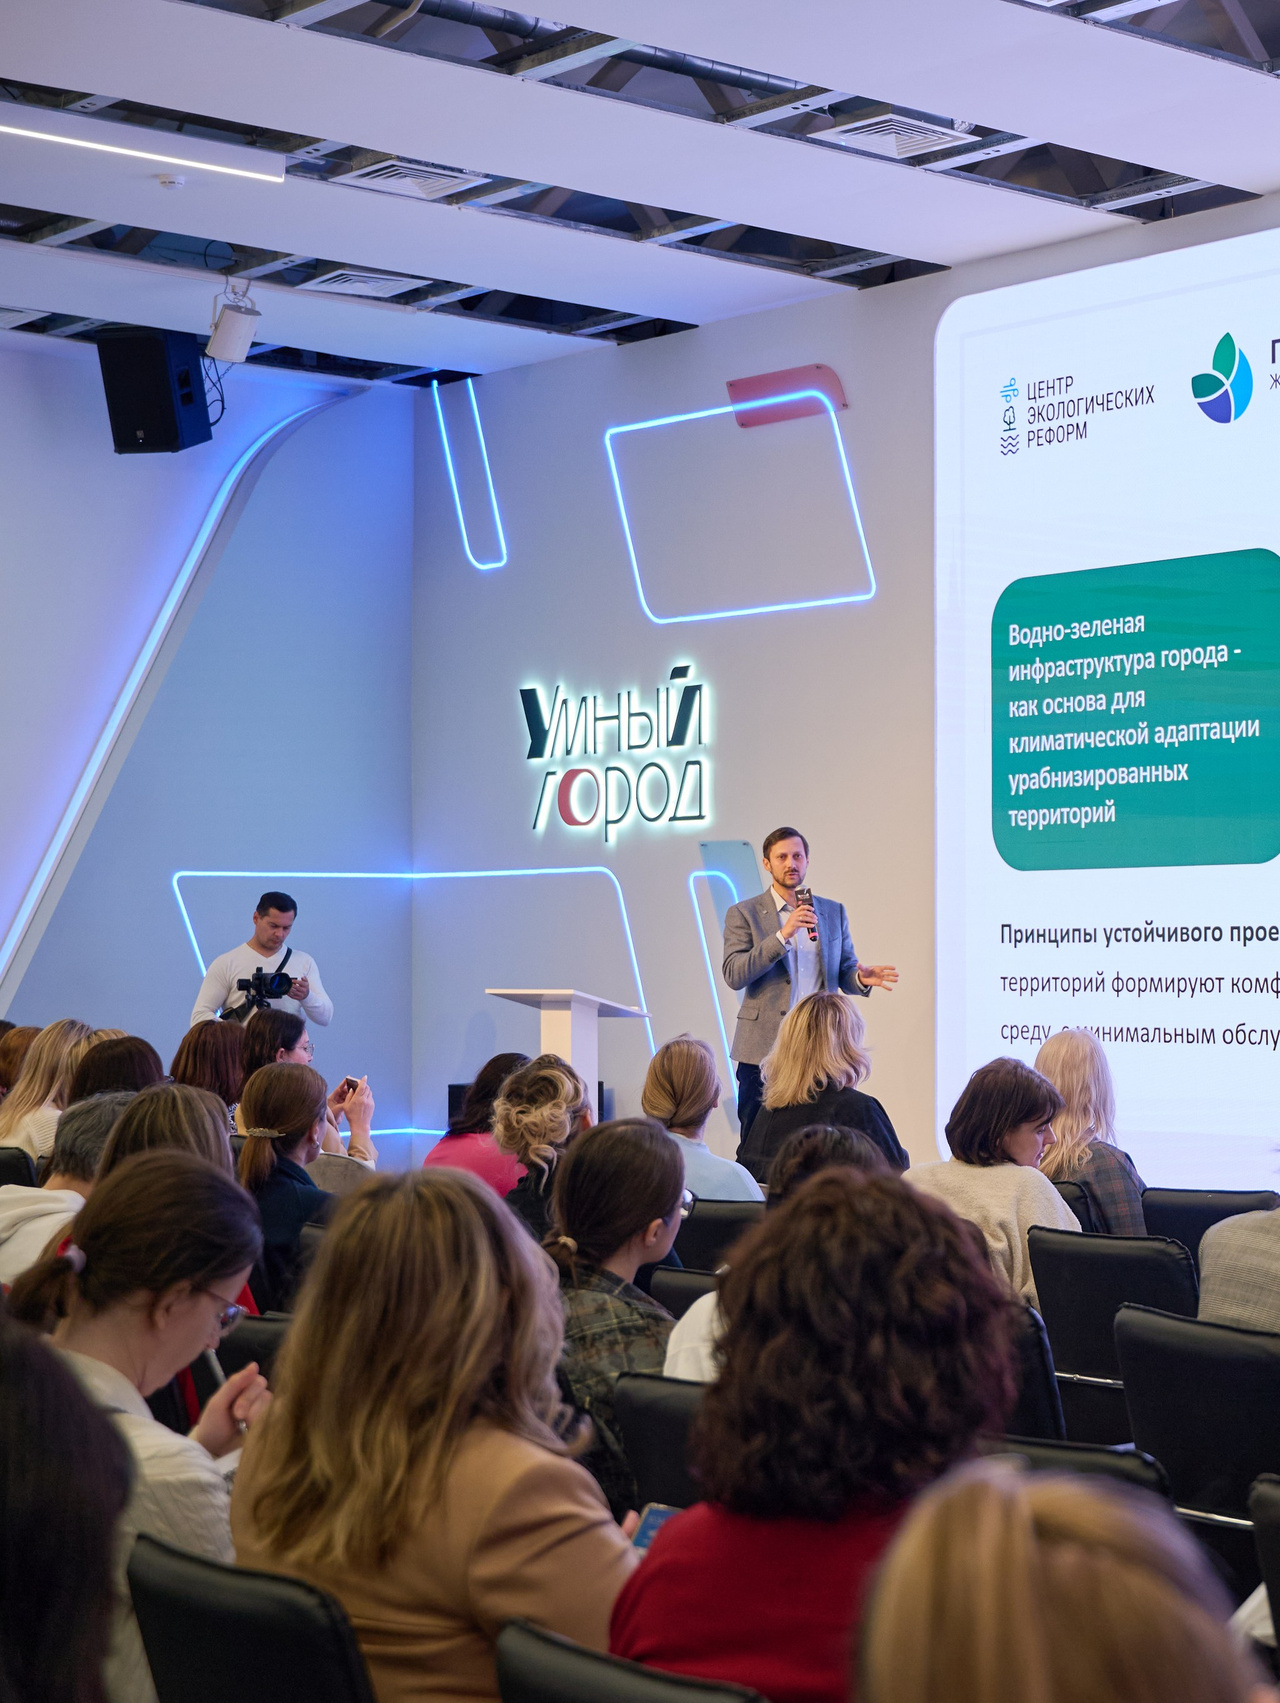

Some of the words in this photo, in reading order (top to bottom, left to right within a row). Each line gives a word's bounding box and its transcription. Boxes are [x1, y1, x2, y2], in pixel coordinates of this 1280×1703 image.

[1027, 375, 1074, 404] ЦЕНТР
[1027, 384, 1155, 425] ЭКОЛОГИЧЕСКИХ
[1027, 420, 1088, 449] РЕФОРМ
[1008, 614, 1145, 649] Водно-зеленая
[1008, 651, 1156, 685] инфраструктура
[1160, 644, 1229, 672] города
[1009, 699, 1039, 718] как
[1042, 693, 1107, 715] основа
[1110, 689, 1146, 715] для
[1009, 720, 1149, 754] климатической
[1154, 719, 1260, 749] адаптации
[1008, 763, 1189, 796] урабнизированных
[1007, 798, 1116, 831] территорий
[1000, 923, 1098, 949] Принципы
[1102, 919, 1224, 949] устойчивого
[999, 970, 1106, 998] территорий
[1111, 970, 1225, 999] формируют
[1074, 1024, 1218, 1047] инимальным
